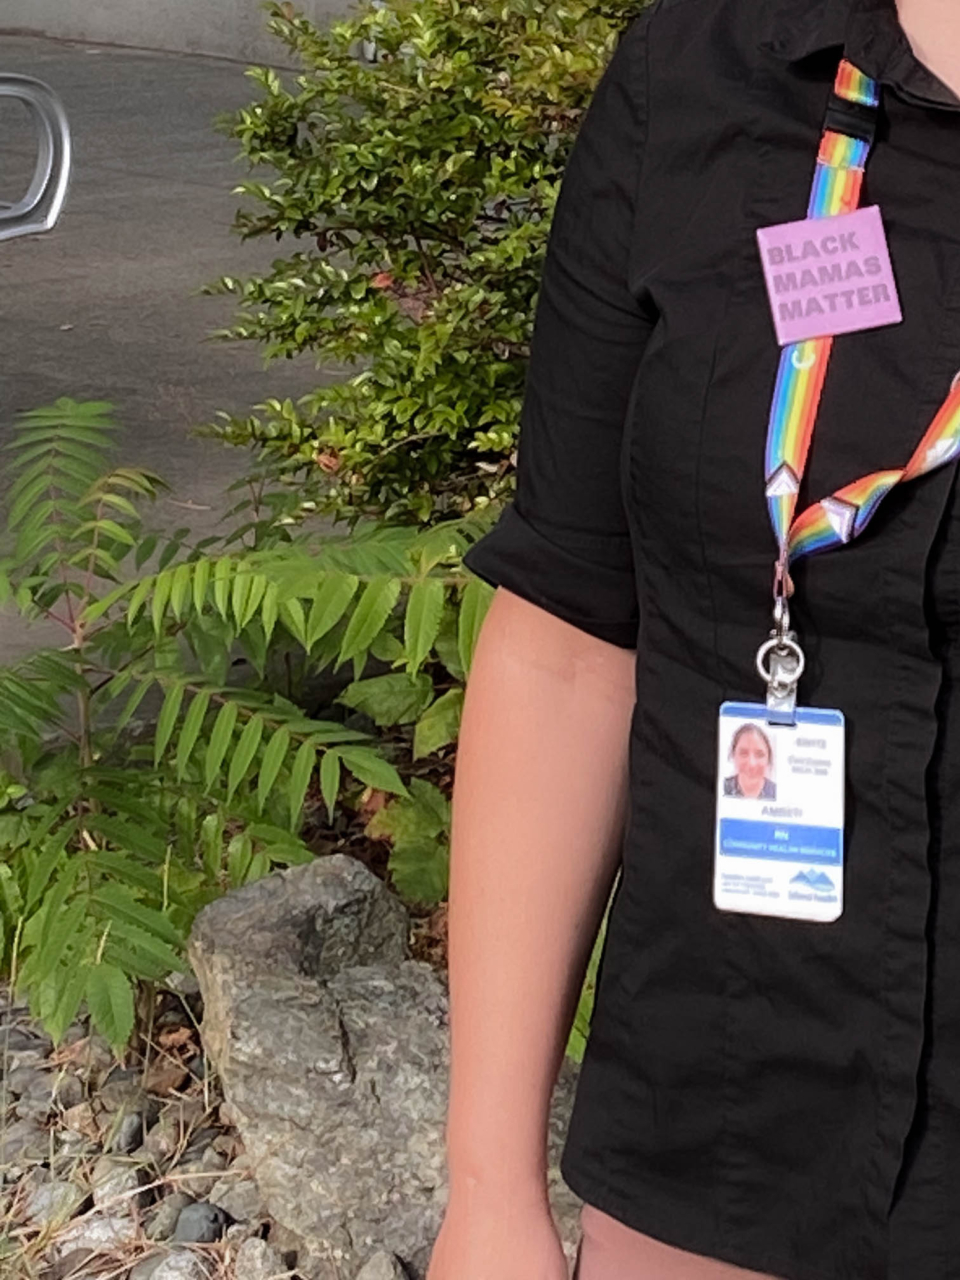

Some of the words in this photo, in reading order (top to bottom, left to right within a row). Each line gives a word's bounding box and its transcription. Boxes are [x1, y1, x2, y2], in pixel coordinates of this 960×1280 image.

[766, 231, 860, 266] BLACK
[772, 255, 883, 295] MAMAS
[778, 283, 891, 321] MATTER
[774, 830, 789, 841] RN
